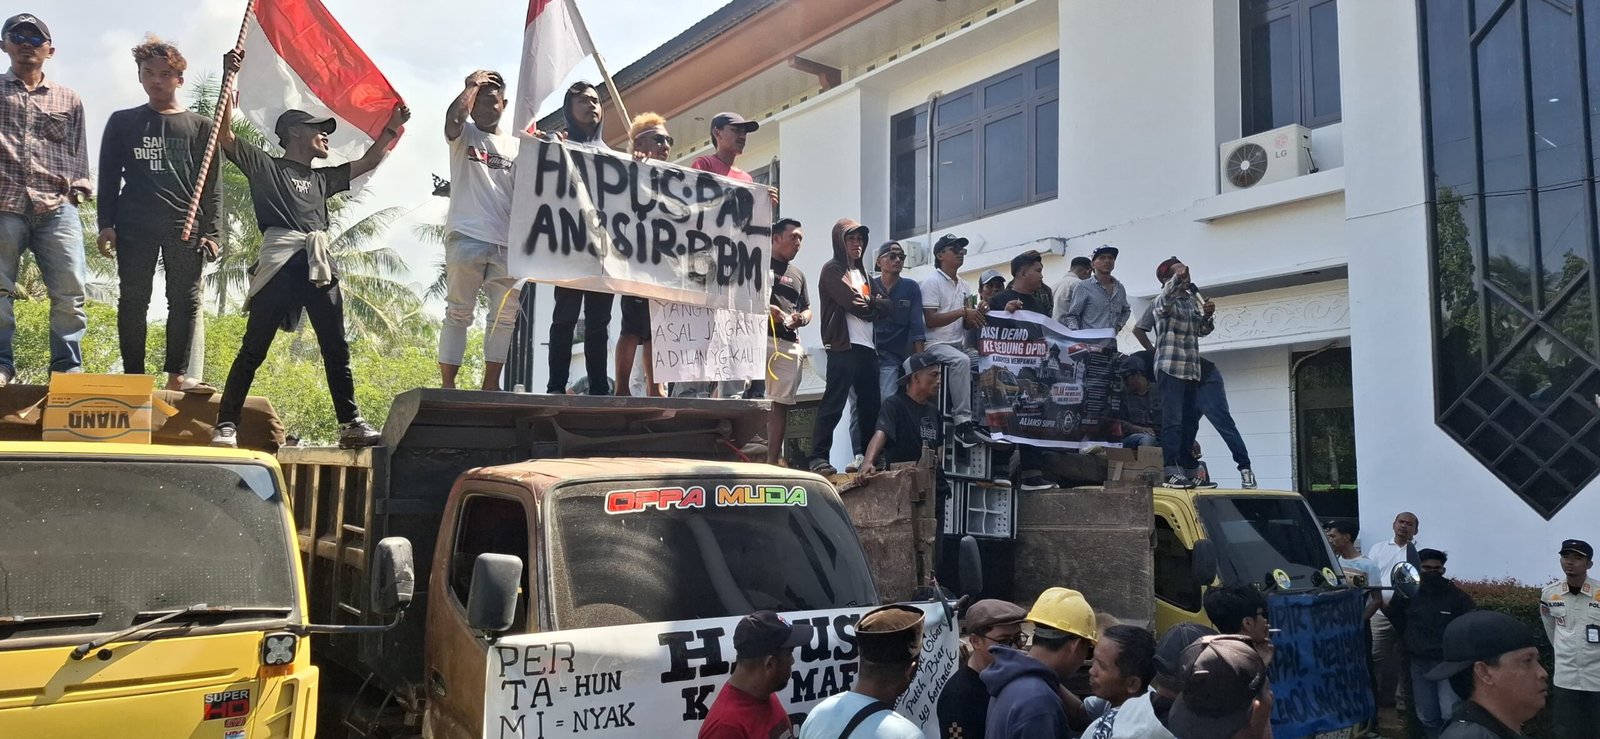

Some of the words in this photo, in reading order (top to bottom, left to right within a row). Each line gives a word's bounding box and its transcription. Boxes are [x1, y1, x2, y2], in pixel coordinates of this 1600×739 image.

[1275, 149, 1288, 159] LG
[654, 321, 697, 345] ASAL
[1001, 327, 1029, 341] DEMO
[1025, 343, 1047, 356] DPRD
[606, 487, 705, 513] OPPA
[717, 486, 807, 506] MUDA
[495, 641, 576, 678] PER
[573, 670, 623, 698] HUN
[790, 661, 859, 704] MAF
[905, 678, 927, 716] Putih
[924, 645, 945, 682] Biar
[927, 648, 958, 705] bertindak
[204, 690, 249, 703] SUPER
[204, 700, 250, 720] HD
[572, 702, 636, 733] NYAK
